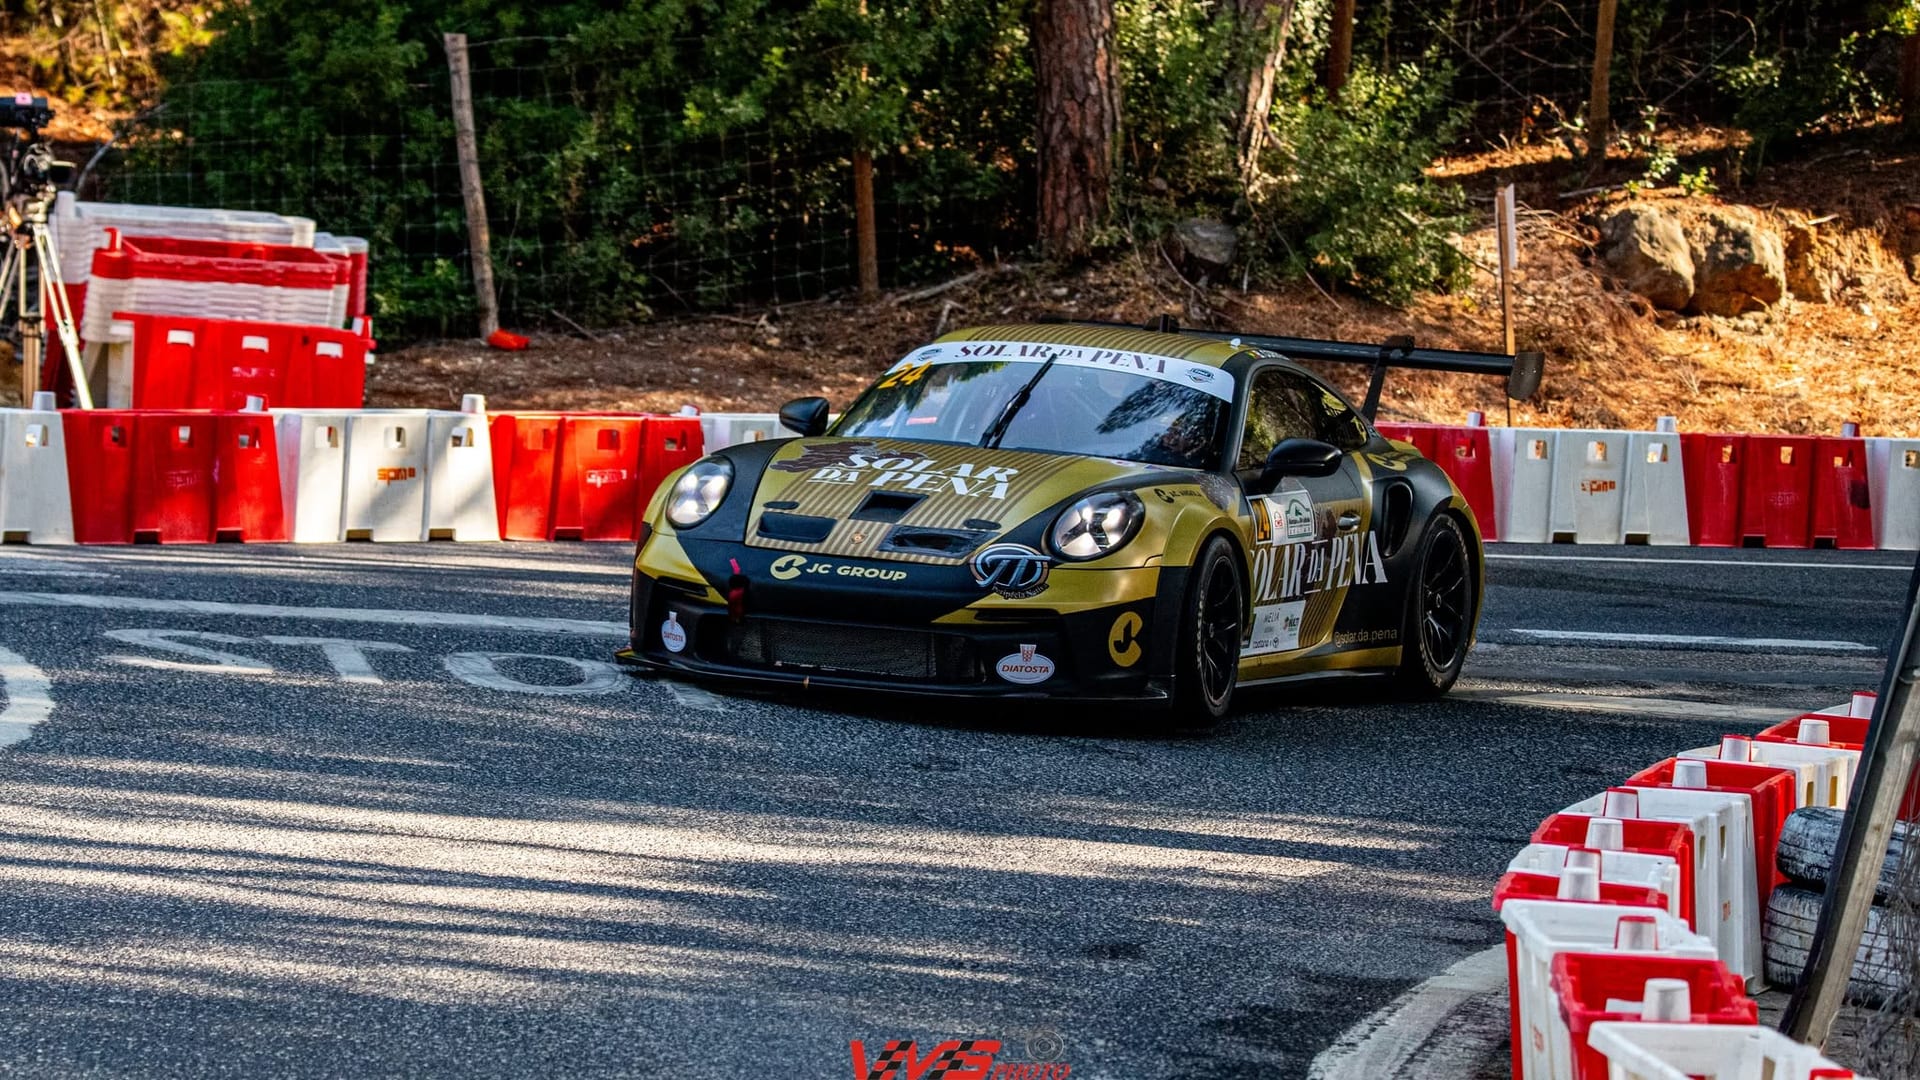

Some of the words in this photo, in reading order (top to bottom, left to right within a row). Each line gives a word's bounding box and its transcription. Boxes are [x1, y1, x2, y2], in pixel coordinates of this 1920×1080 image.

[954, 343, 1052, 361] SOLAR
[1089, 350, 1167, 375] PENA
[877, 361, 933, 389] 24
[838, 453, 1019, 482] SOLAR
[811, 468, 860, 483] DA
[868, 471, 1011, 500] PENA
[806, 564, 831, 574] JC
[836, 566, 907, 581] GROUP
[1250, 543, 1306, 603] OLAR
[1306, 547, 1325, 584] DA
[1325, 530, 1389, 591] PENA
[100, 628, 730, 705] STO
[1001, 664, 1050, 674] DIATOSTA
